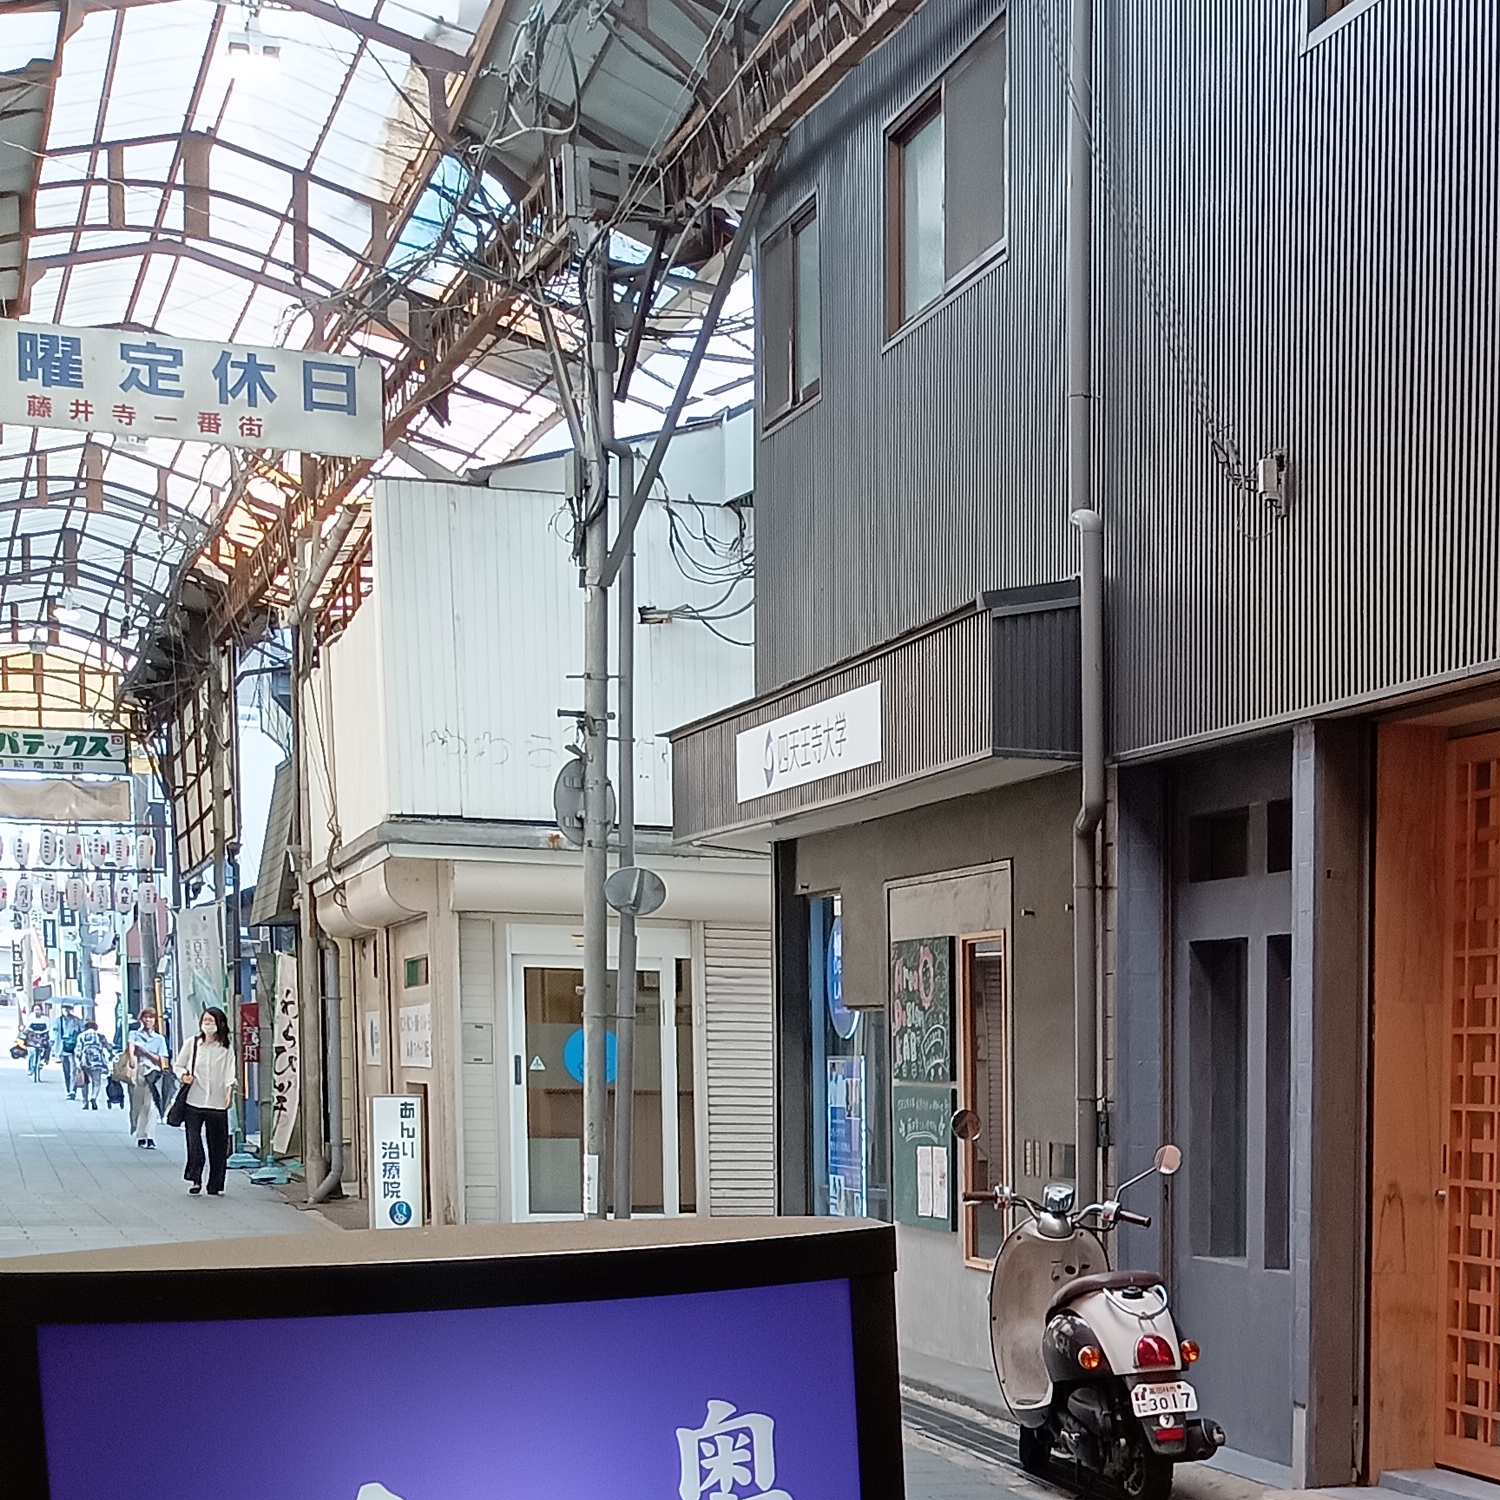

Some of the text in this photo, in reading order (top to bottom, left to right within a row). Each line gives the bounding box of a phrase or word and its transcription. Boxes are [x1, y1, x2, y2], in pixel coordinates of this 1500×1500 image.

[17, 331, 358, 417] 曜定休日
[26, 394, 264, 438] 藤井寺一番街
[778, 711, 847, 773] 四天王寺大学
[381, 1140, 402, 1200] 治療院
[1149, 1393, 1190, 1411] 3017
